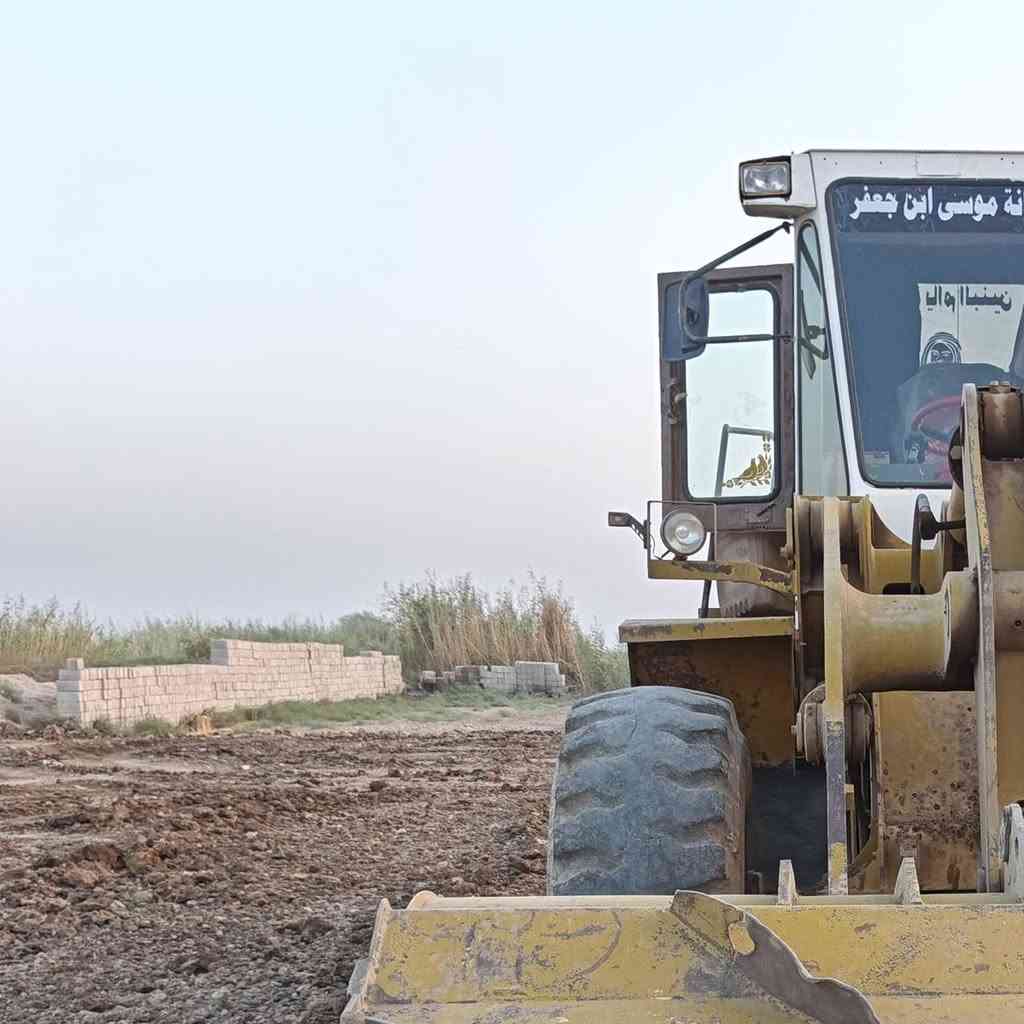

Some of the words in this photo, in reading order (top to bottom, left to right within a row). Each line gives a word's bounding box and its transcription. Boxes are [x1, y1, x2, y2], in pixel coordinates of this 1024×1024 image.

[849, 185, 898, 220] جعفر
[903, 187, 933, 221] ابن
[937, 193, 998, 222] موسى
